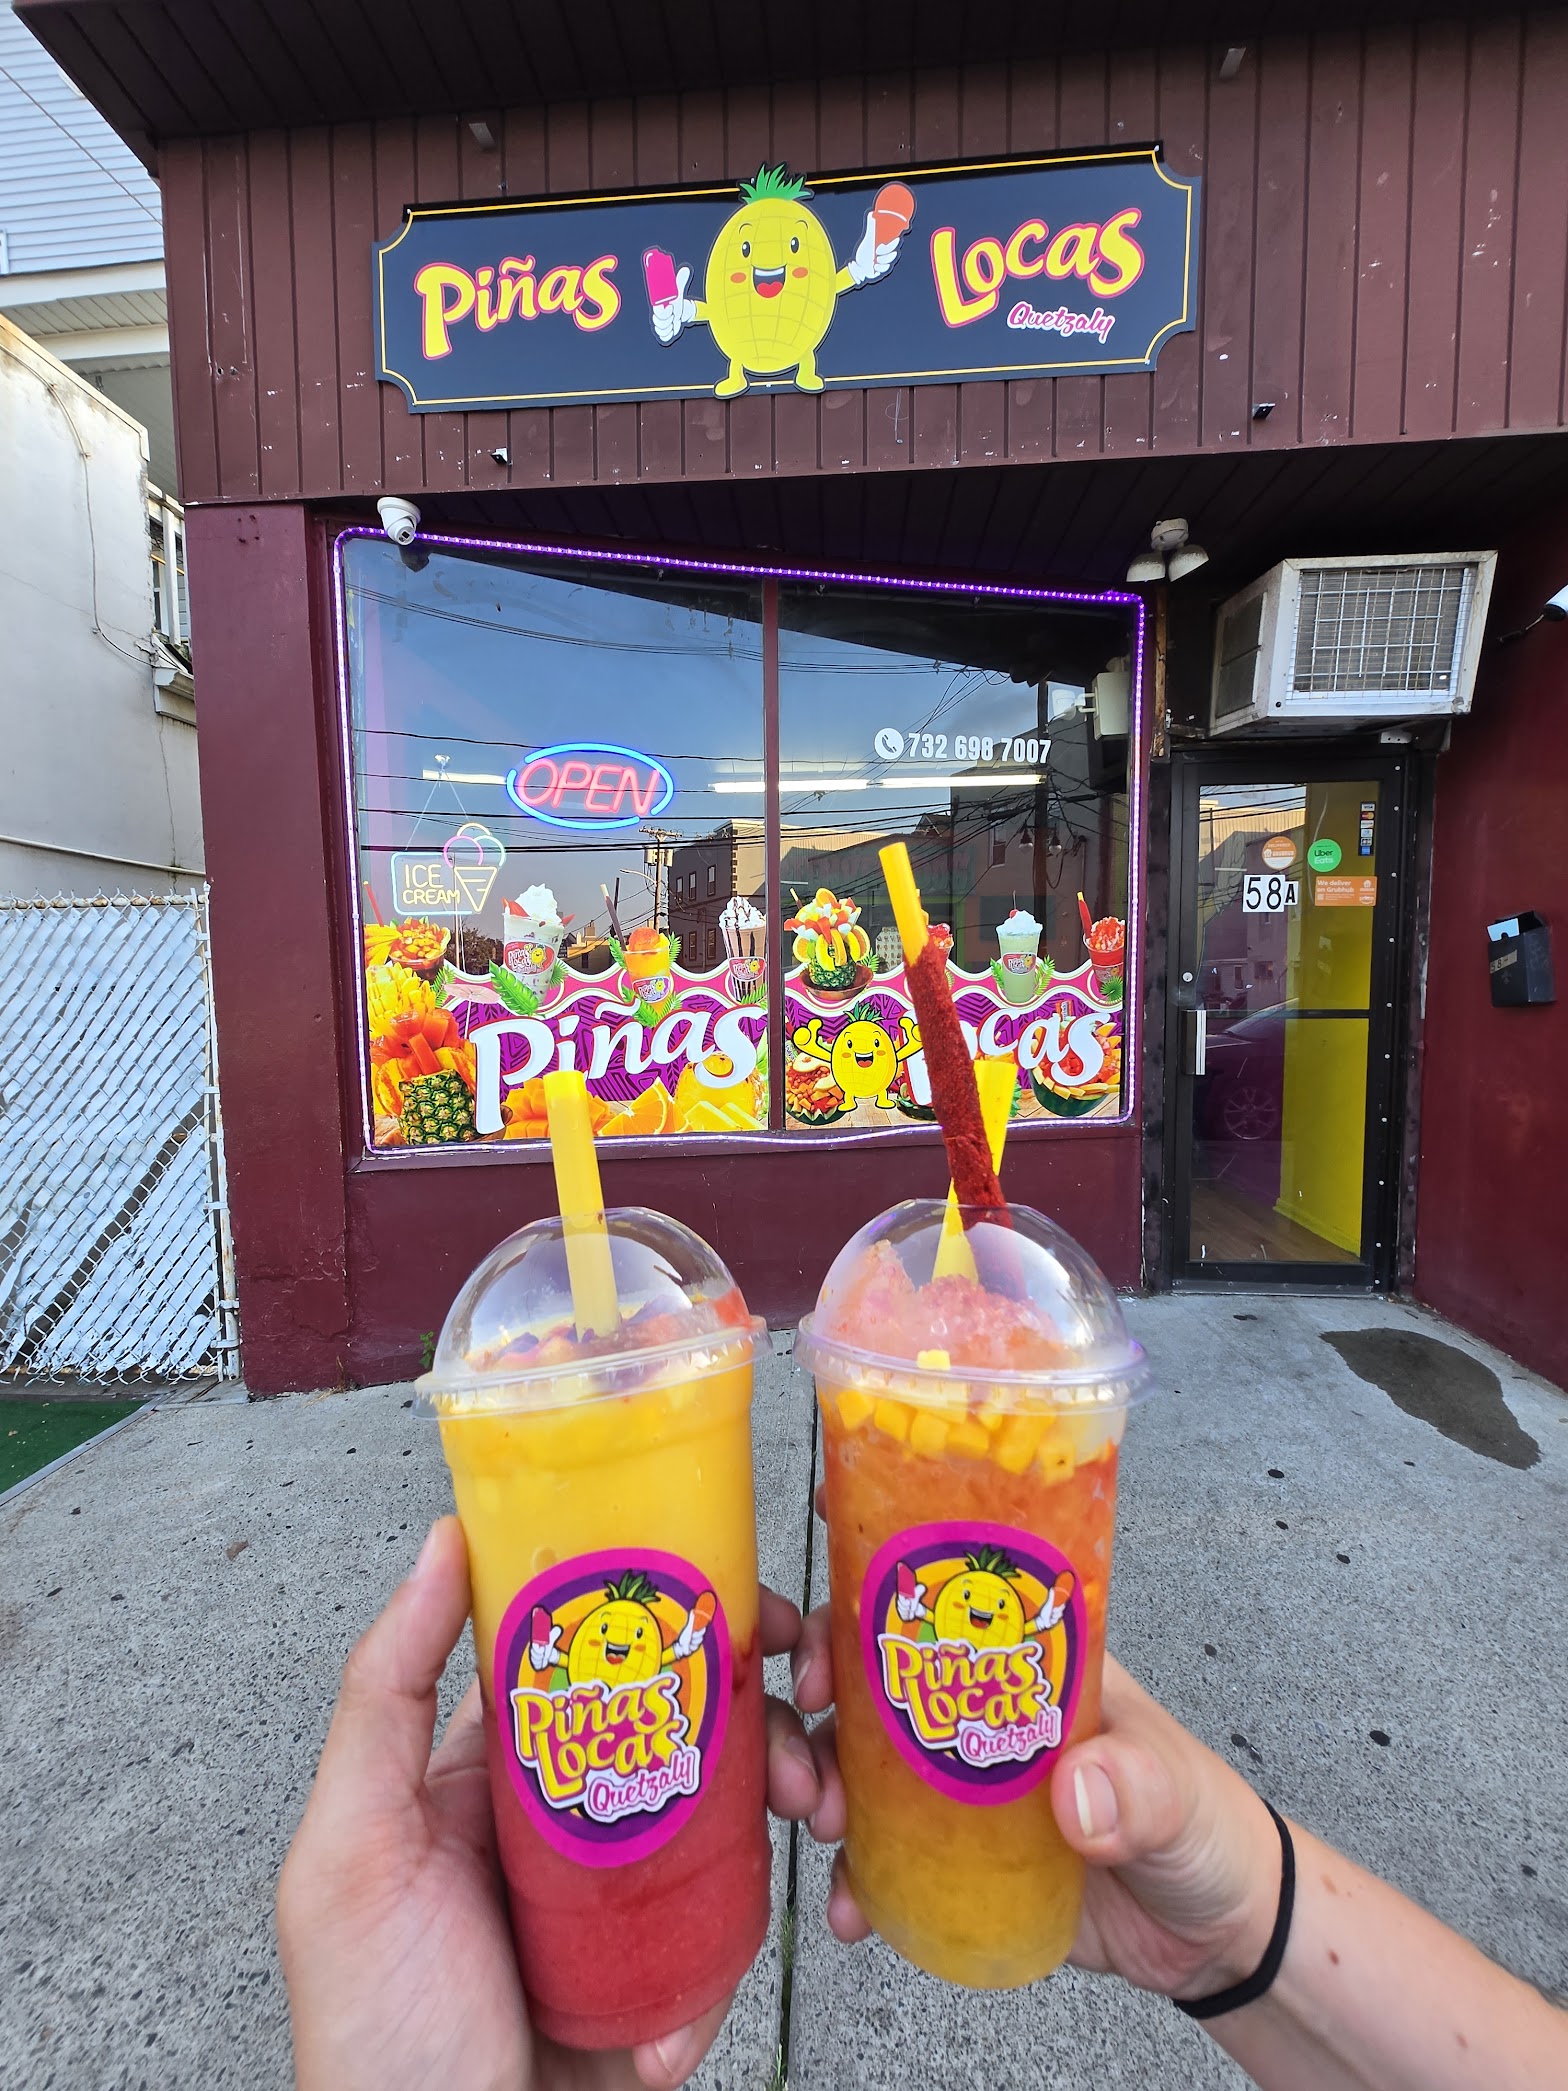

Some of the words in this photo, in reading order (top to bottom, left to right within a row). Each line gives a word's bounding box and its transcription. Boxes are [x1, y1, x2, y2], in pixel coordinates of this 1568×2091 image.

[414, 253, 621, 360] Piñas
[930, 207, 1146, 329] Locas
[1007, 300, 1117, 344] Quetzaly
[908, 732, 948, 759] 732
[954, 735, 994, 762] 698
[1001, 738, 1052, 764] 7007
[518, 758, 660, 816] OPEN
[402, 888, 461, 905] CREAM
[404, 863, 441, 889] ICE
[471, 997, 767, 1134] Piñas
[902, 1007, 1111, 1106] cas
[881, 1639, 1038, 1701] Piñas
[514, 1677, 676, 1758] Piñas
[905, 1683, 1045, 1742] Locas
[963, 1712, 1055, 1760] Quetzaly
[535, 1718, 681, 1799] Locas
[591, 1753, 692, 1812] Quetzaly
